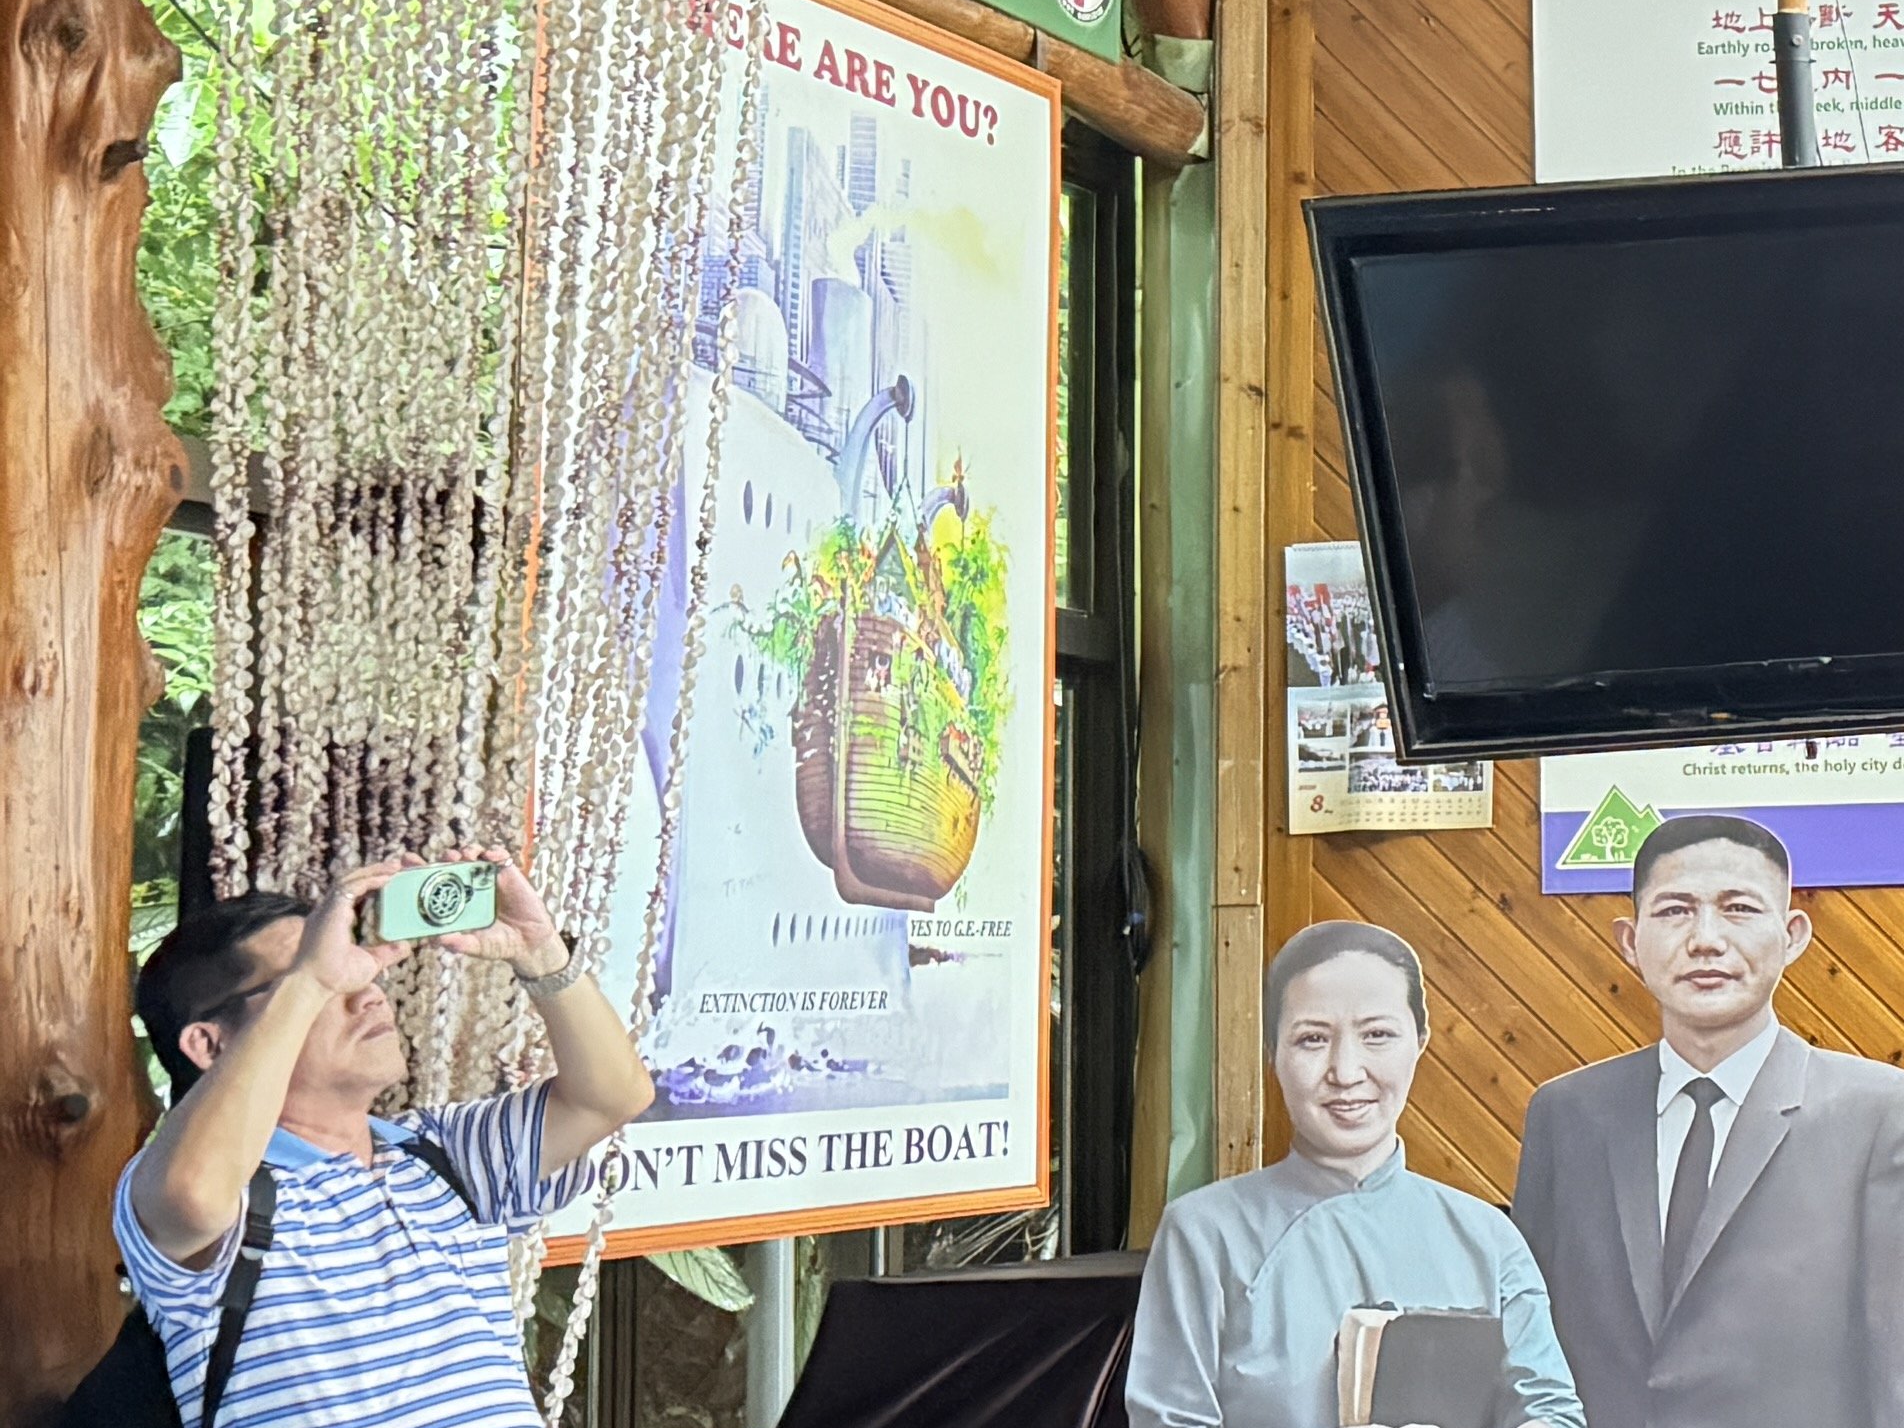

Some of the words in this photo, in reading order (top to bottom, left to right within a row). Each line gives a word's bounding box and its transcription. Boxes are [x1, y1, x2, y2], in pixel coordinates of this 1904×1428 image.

[1697, 39, 1751, 60] Earthly
[813, 39, 896, 107] ARE
[907, 73, 998, 147] YOU?
[1713, 101, 1764, 117] Within
[1849, 96, 1902, 113] middle
[1682, 761, 1727, 778] Christ
[1823, 756, 1857, 775] holy
[1860, 756, 1888, 775] city
[910, 920, 931, 937] YES
[935, 920, 952, 937] TO
[699, 991, 798, 1014] EXTINCTION
[801, 991, 816, 1011] IS
[818, 990, 888, 1012] FOREVER
[713, 1134, 808, 1184] MISS
[818, 1128, 893, 1173] THE
[903, 1119, 1010, 1165] BOAT!
